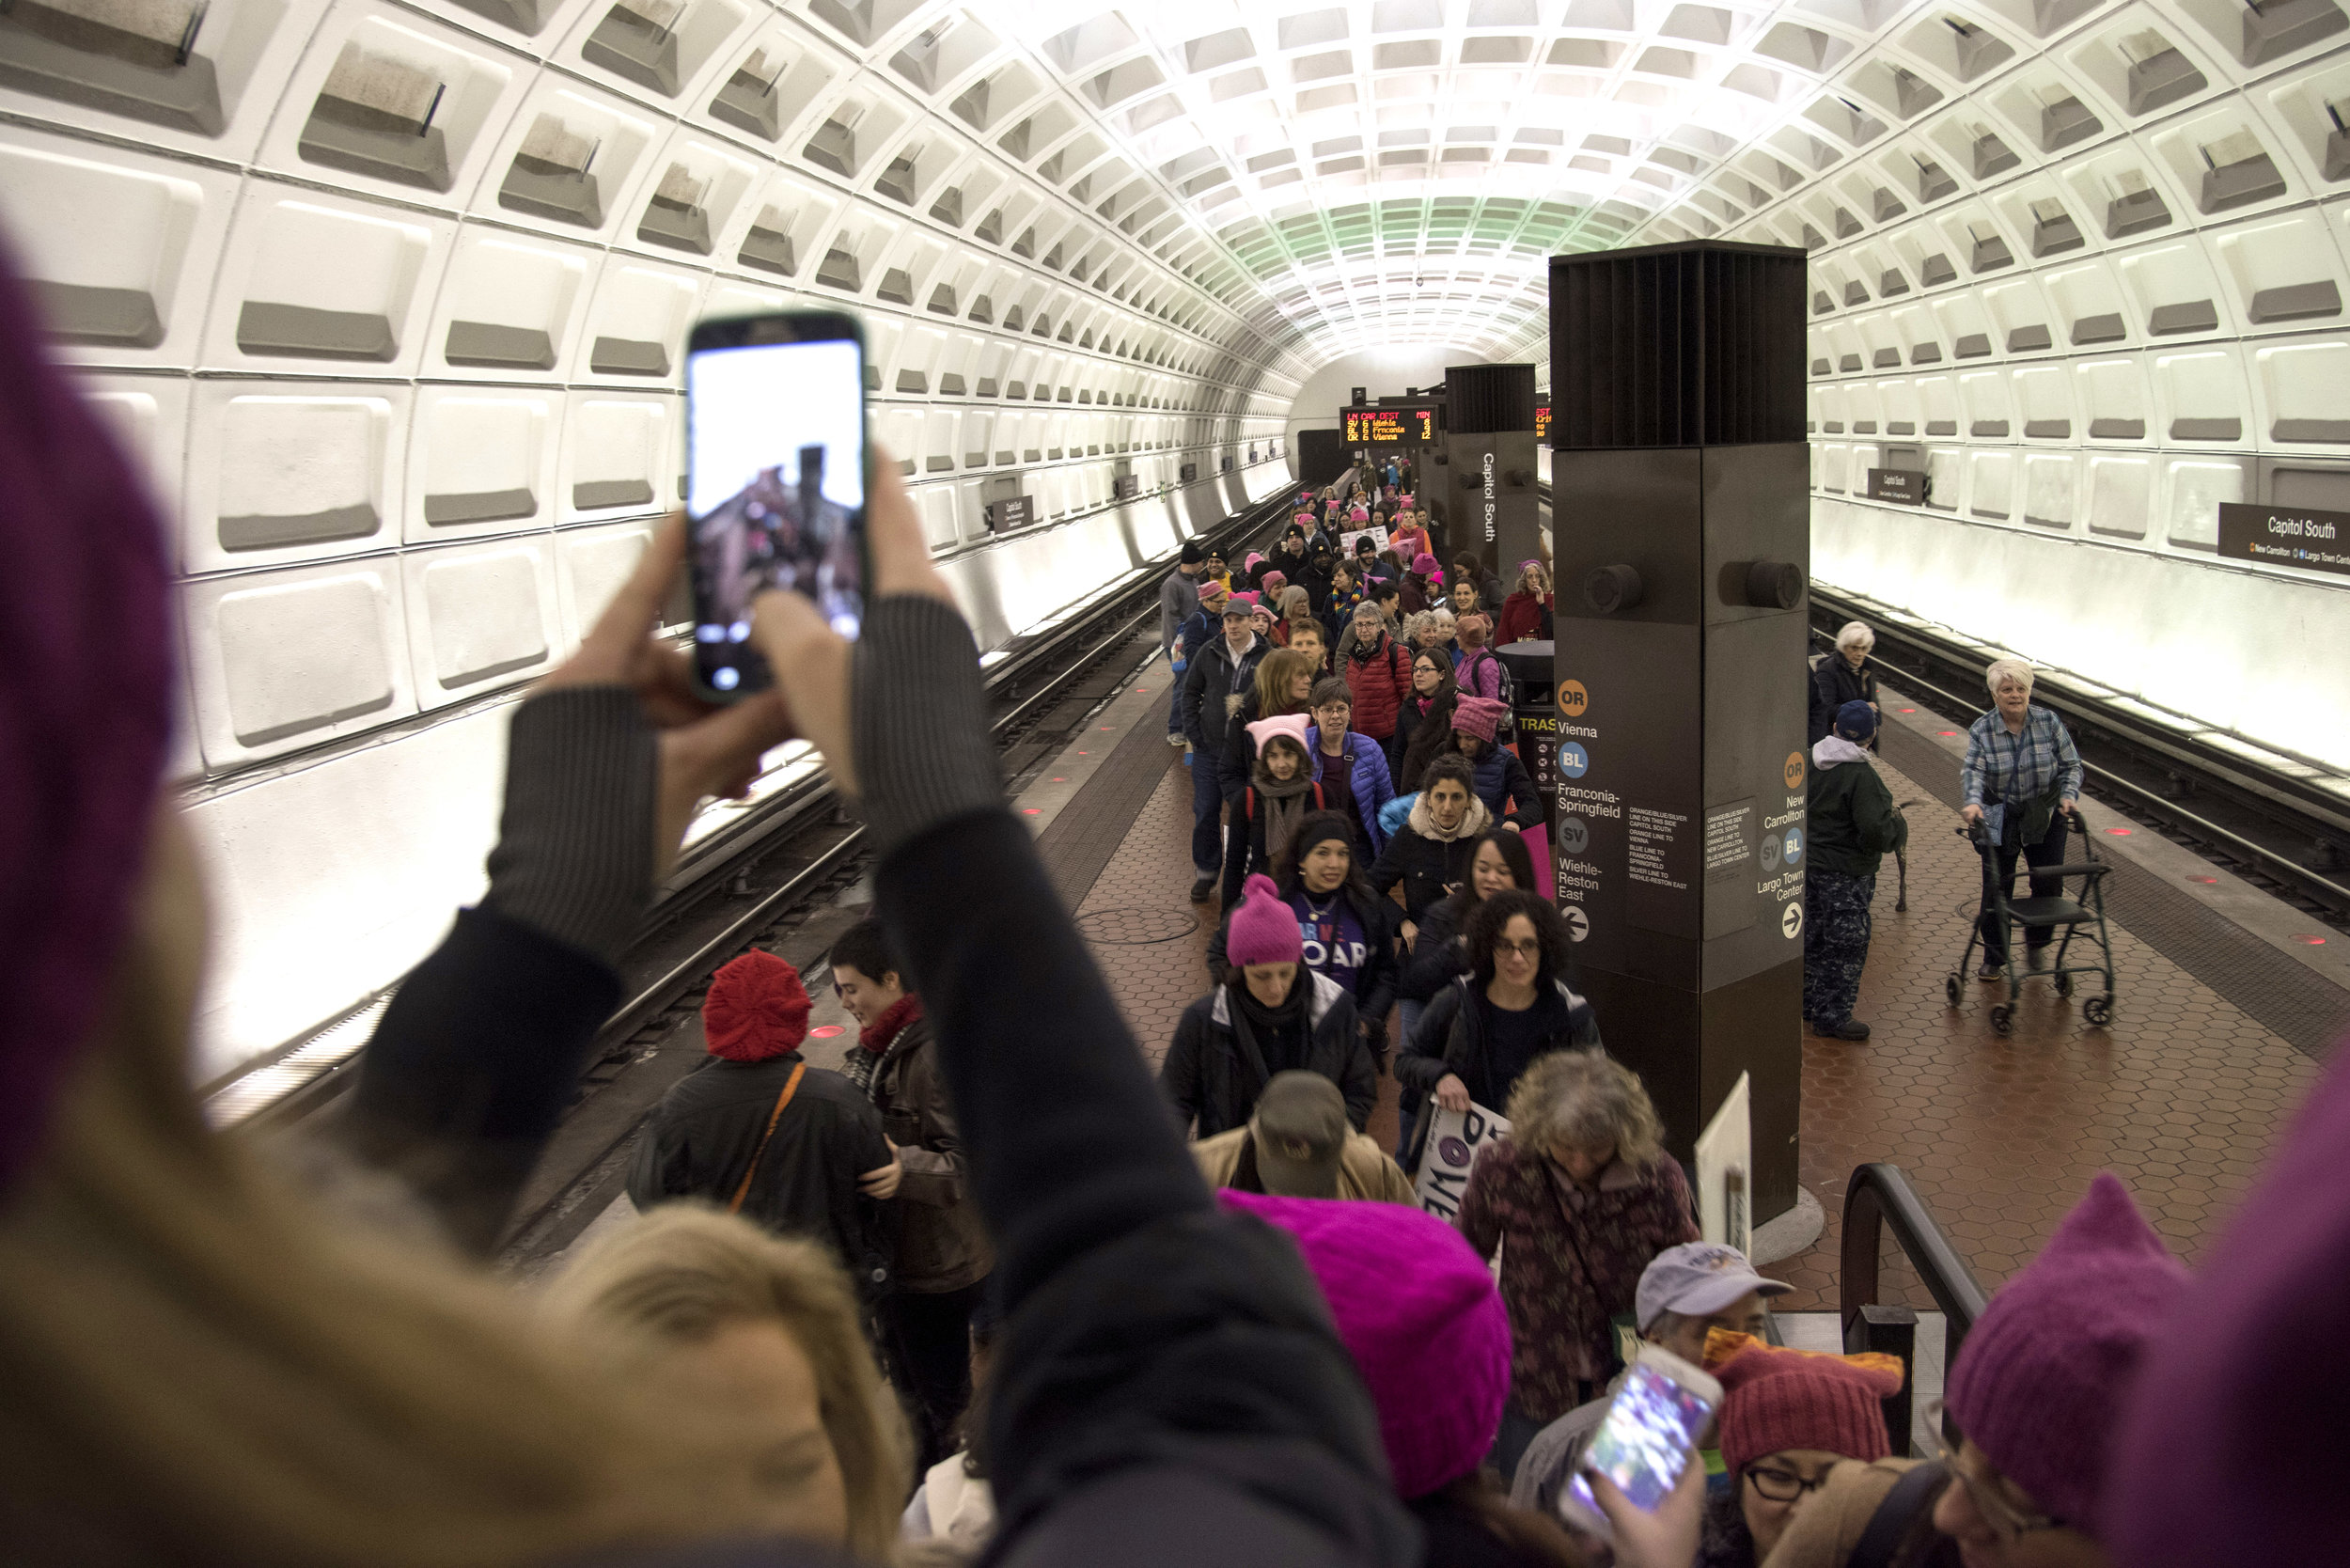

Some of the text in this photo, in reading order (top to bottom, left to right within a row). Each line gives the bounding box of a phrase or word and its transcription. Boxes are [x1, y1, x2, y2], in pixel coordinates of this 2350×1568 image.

[1417, 411, 1431, 419] MIN
[1482, 453, 1496, 542] Capitol South
[2268, 516, 2335, 540] Capitol South
[2255, 543, 2265, 554] New
[2305, 550, 2321, 562] Largo
[2321, 553, 2335, 563] Town
[1561, 691, 1584, 705] OR
[1519, 718, 1556, 731] TRAS
[1559, 721, 1598, 738] Vienna
[1563, 752, 1584, 768] BL
[1786, 762, 1803, 778] OR
[1559, 783, 1620, 803] Franconia-
[1559, 797, 1621, 819] Springfield
[1787, 795, 1804, 808] New
[1629, 821, 1671, 833] CAPITOL SOUTH
[1764, 809, 1804, 829] Carrollton
[1564, 827, 1584, 843] SV
[1629, 829, 1652, 838] ORANGE
[1629, 836, 1649, 844] VIENNA
[1629, 844, 1643, 853] BLUE
[1644, 846, 1656, 855] LINE
[1762, 839, 1800, 860] SV BL
[1559, 857, 1602, 876] Wiehle-
[1629, 857, 1664, 870] SPRINGFIELD
[1707, 860, 1721, 870] LARGO
[1734, 851, 1749, 861] CENTER
[1629, 866, 1647, 874] SILVER
[1559, 872, 1599, 890] Reston
[1758, 870, 1804, 894] Largo Town
[1559, 886, 1584, 902] East
[1777, 885, 1803, 902] Center
